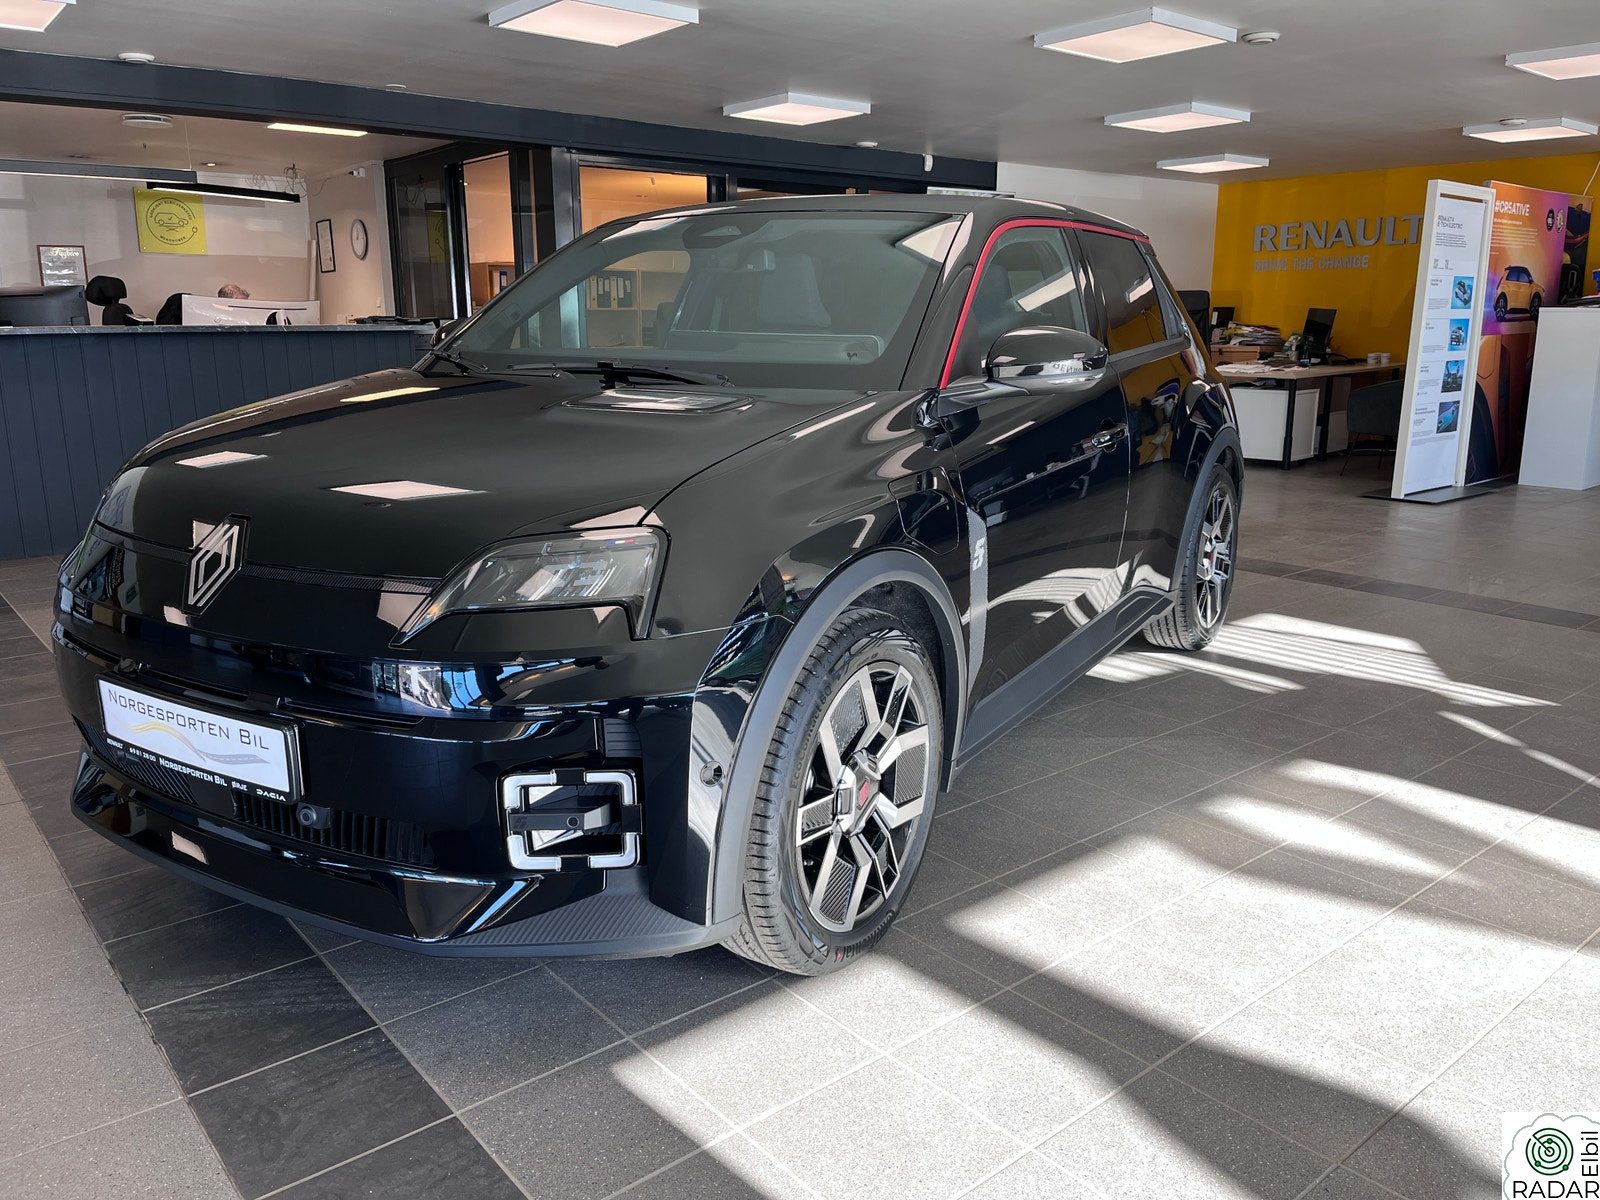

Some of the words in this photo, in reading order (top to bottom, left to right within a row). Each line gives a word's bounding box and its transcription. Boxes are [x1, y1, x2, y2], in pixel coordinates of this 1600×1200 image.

[1253, 214, 1424, 252] RENAULT
[1254, 258, 1288, 273] DRIVE
[1293, 257, 1314, 271] THE
[1318, 254, 1369, 270] CHANGE
[108, 688, 230, 740] NORGESPORTEN
[256, 788, 287, 802] DACIA
